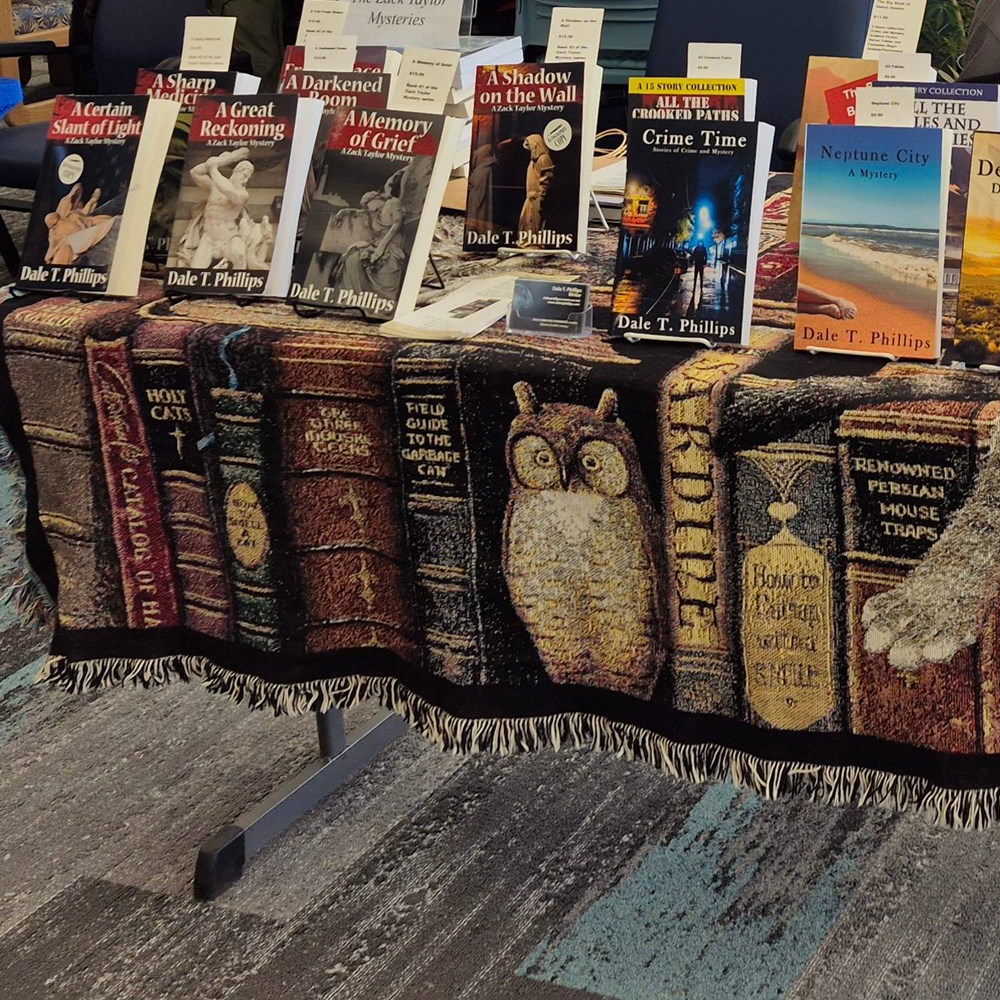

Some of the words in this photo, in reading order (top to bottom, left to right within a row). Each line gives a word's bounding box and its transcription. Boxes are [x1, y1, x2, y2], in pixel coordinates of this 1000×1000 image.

[368, 12, 425, 27] Mysteries
[152, 75, 164, 87] A
[167, 73, 216, 91] Sharp
[285, 74, 298, 89] A
[302, 75, 383, 93] Darkened
[487, 71, 498, 85] A
[503, 68, 571, 86] Shadow
[308, 91, 357, 107] Room
[929, 87, 983, 97] COLLECTION
[71, 103, 83, 116] A
[83, 103, 132, 117] Certain
[215, 102, 228, 117] A
[230, 102, 275, 118] Great
[515, 105, 536, 113] Taylor
[537, 105, 565, 113] Mystery
[656, 96, 680, 109] ALL
[682, 96, 710, 109] THE
[931, 102, 966, 115] THE
[632, 108, 694, 121] CROOKED
[696, 109, 739, 122] PATHS
[53, 119, 89, 135] Slant
[90, 121, 108, 138] of
[107, 119, 142, 138] Light
[200, 120, 285, 141] Reckoning
[343, 110, 356, 126] A
[360, 111, 433, 137] Memory
[943, 119, 981, 131] AND
[350, 130, 369, 150] of
[371, 132, 418, 153] Grief
[643, 128, 694, 146] Crime
[701, 130, 747, 148] Time
[712, 148, 734, 156] Mystery
[821, 145, 888, 163] Neptune
[896, 150, 930, 166] City
[848, 169, 856, 177] A
[860, 169, 899, 181] Mystery
[146, 388, 188, 404] HOLY
[150, 405, 192, 422] CATS
[405, 402, 445, 416] FIELD
[406, 418, 449, 431] GUIDE
[406, 433, 425, 447] TO
[426, 433, 452, 447] THE
[401, 449, 460, 463] GARBAGE
[418, 464, 447, 477] CAN
[852, 457, 956, 481] RENOWNED
[868, 480, 945, 499] PERSIAN
[880, 502, 940, 522] MOUSE
[881, 521, 938, 541] TRAPS
